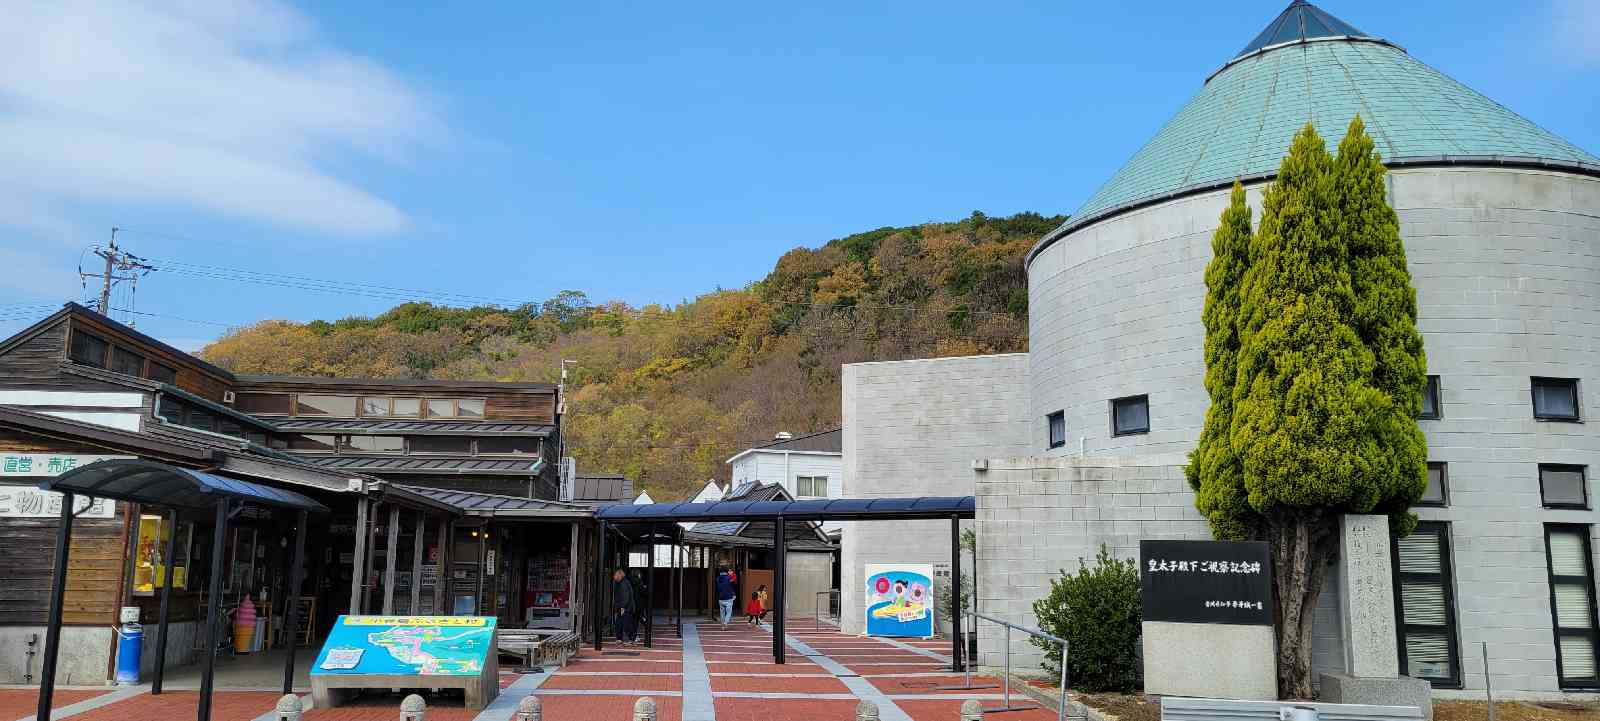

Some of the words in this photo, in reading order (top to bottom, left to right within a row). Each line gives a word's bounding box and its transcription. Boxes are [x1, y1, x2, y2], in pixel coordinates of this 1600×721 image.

[1148, 559, 1261, 573] 皇太子殿下ご視察記念碑
